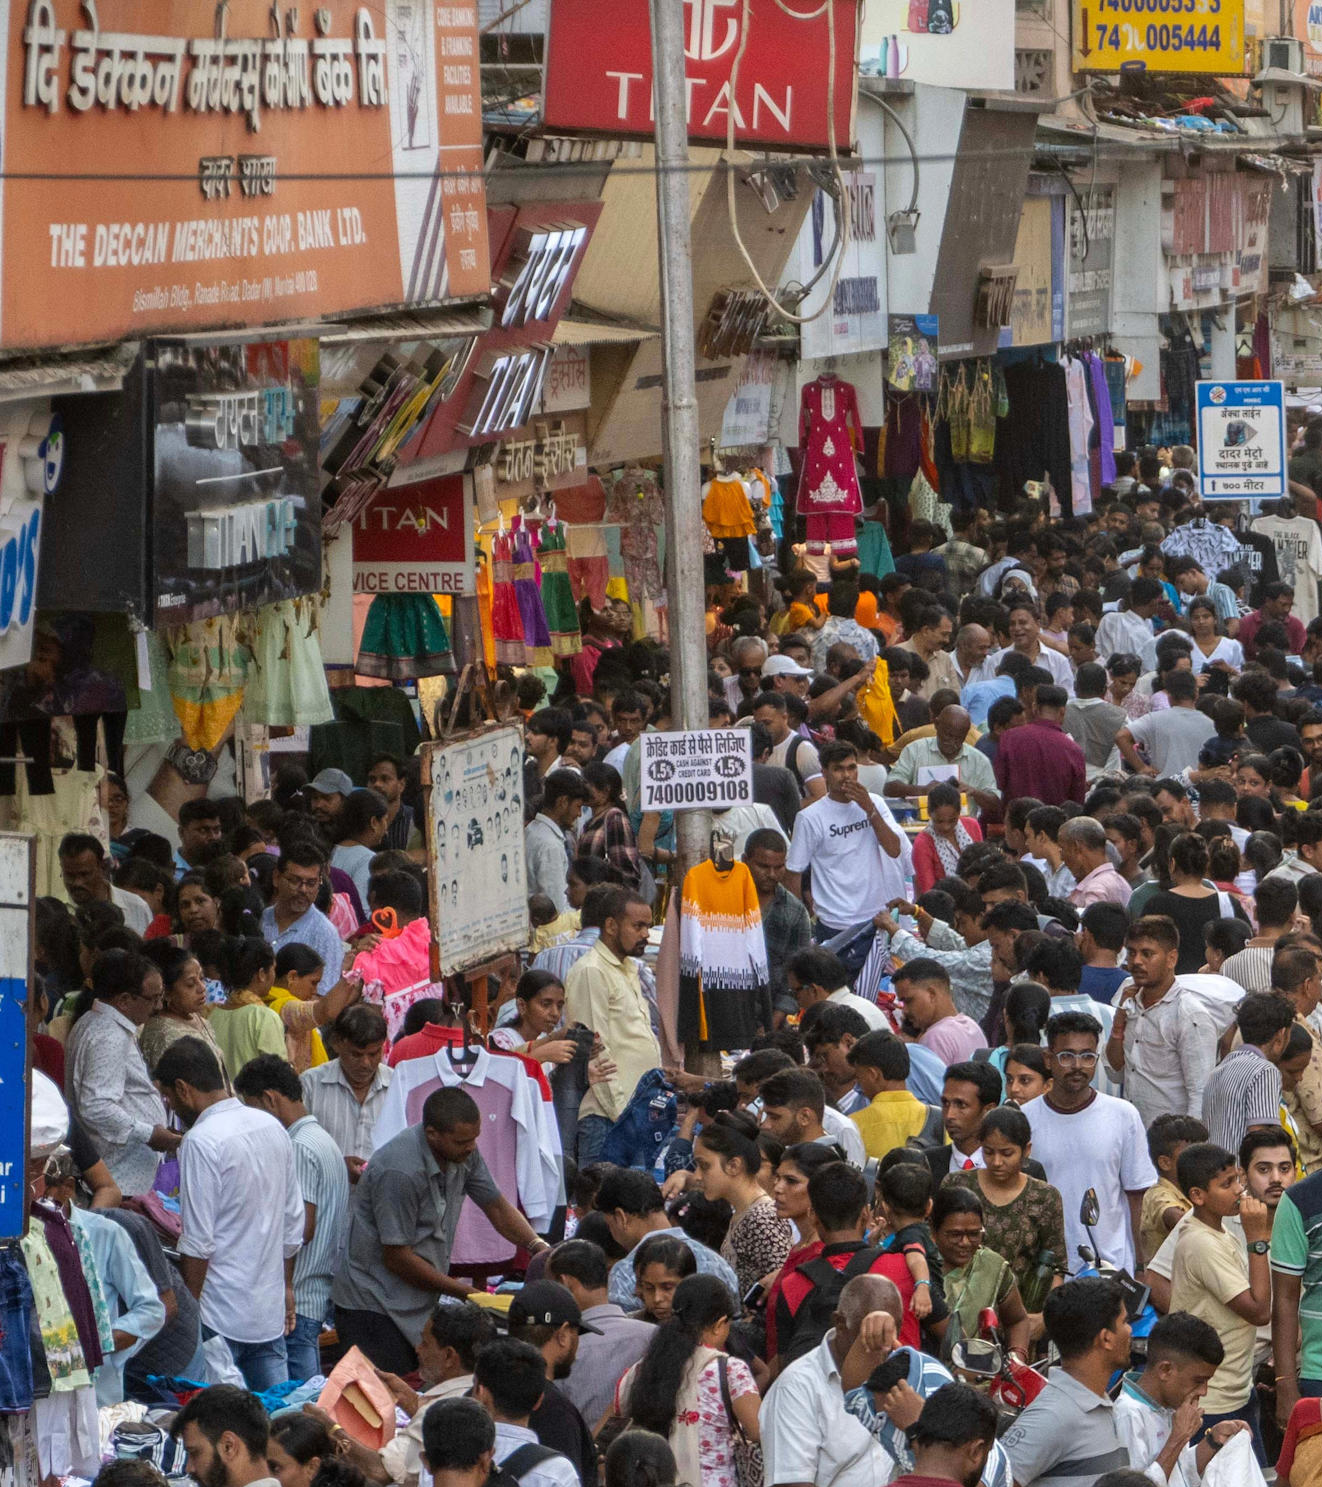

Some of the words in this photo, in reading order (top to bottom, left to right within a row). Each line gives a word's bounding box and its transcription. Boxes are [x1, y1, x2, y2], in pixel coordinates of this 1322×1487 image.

[50, 223, 86, 268] THE
[94, 221, 168, 268] DECCAN
[172, 216, 259, 264] MERCHANTS
[297, 209, 334, 250] BANK
[337, 206, 367, 247] LTD.
[1219, 449, 1241, 459] दादर
[1244, 479, 1264, 490] मीटर
[359, 506, 449, 531] ITAN
[353, 572, 389, 591] VICE
[394, 572, 464, 591] CENTRE
[688, 735, 696, 755] से
[676, 760, 689, 768] CASH
[691, 758, 712, 767] AGAINST
[678, 769, 696, 778] CREDIT
[697, 768, 711, 777] CARD
[646, 780, 749, 805] 7400009108
[829, 819, 873, 838] Suprem
